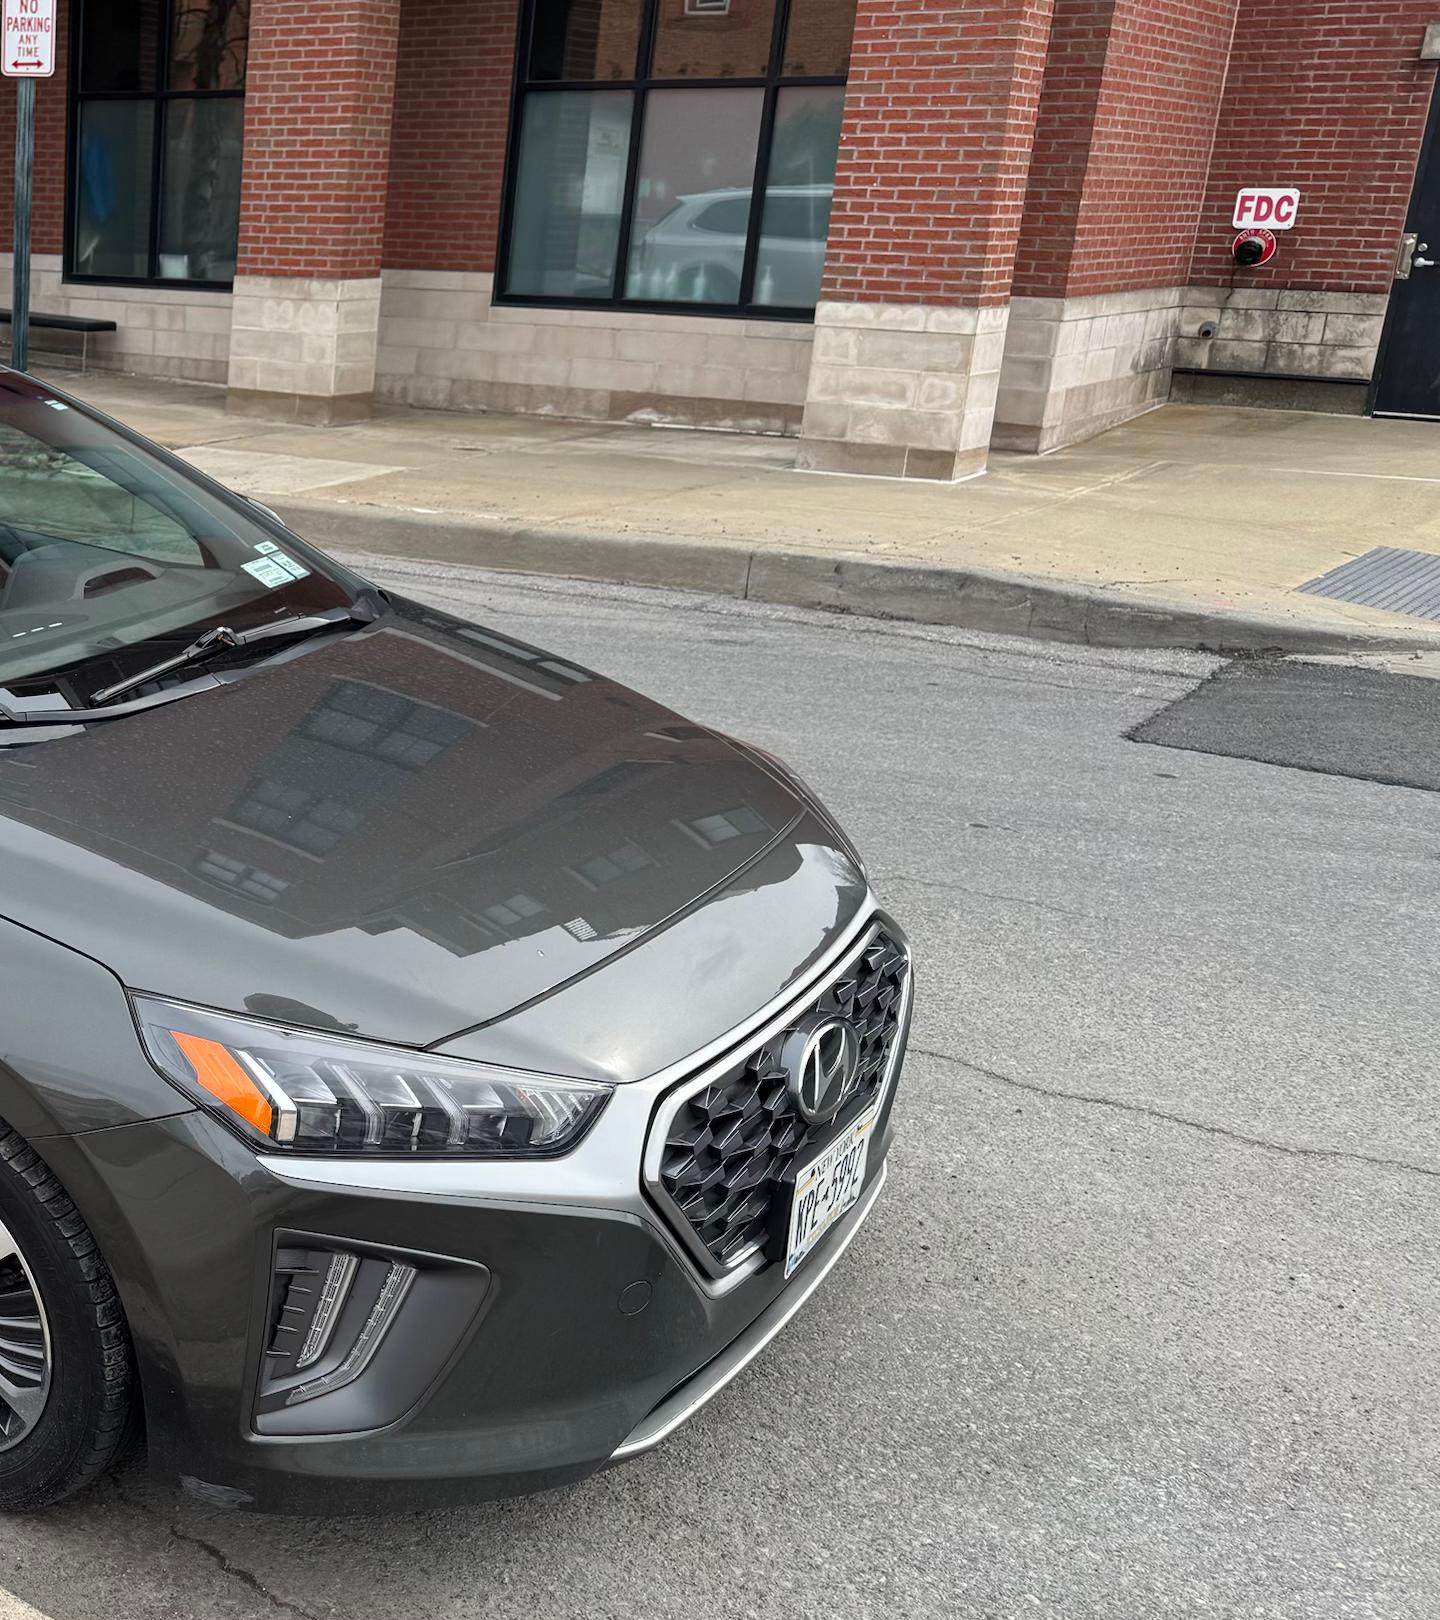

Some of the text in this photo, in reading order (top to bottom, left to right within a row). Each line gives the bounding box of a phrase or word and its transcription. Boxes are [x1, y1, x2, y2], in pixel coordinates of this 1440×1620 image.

[19, 0, 38, 14] NO
[6, 17, 51, 32] PARKING
[18, 34, 39, 45] ANY
[17, 47, 40, 57] TIME
[1236, 195, 1294, 223] FDC
[816, 1157, 833, 1182] NEW
[834, 1135, 854, 1163] YORK
